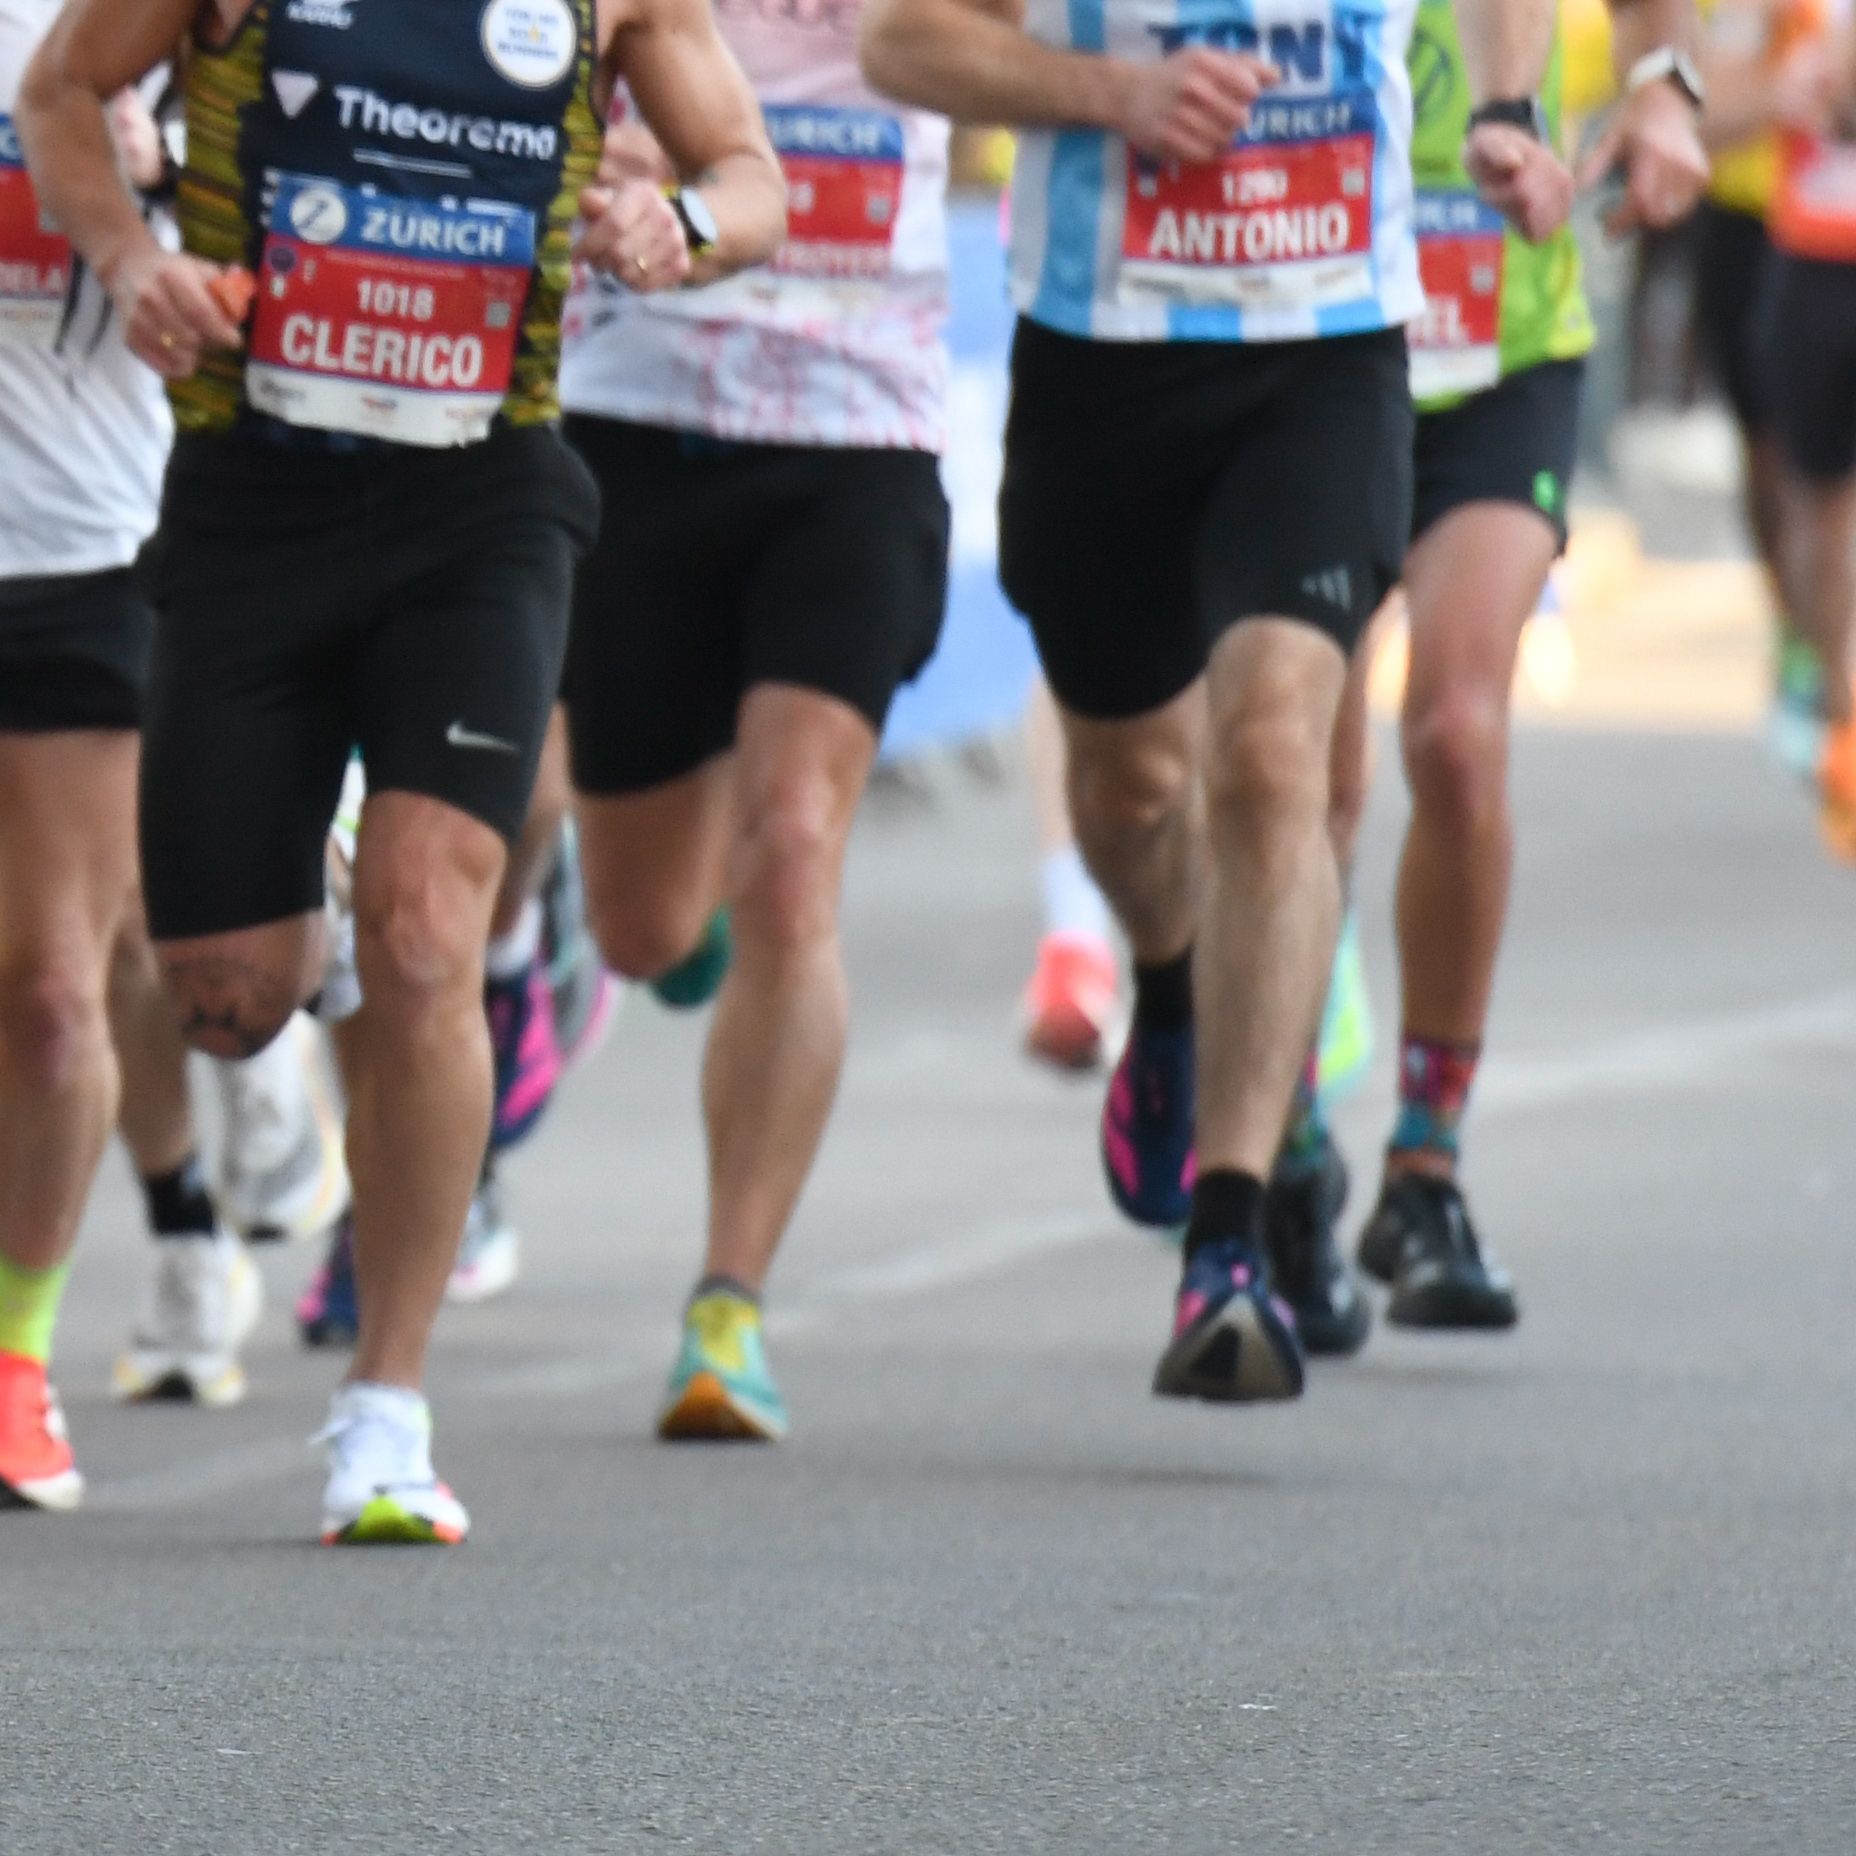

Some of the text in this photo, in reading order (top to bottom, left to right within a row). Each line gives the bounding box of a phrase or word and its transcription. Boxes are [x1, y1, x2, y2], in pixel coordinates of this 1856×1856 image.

[334, 85, 558, 161] Theorema
[361, 206, 505, 256] ZURICH
[1147, 203, 1350, 261] ANTONIO
[357, 279, 435, 322] 1018
[280, 312, 484, 387] CLERICO
